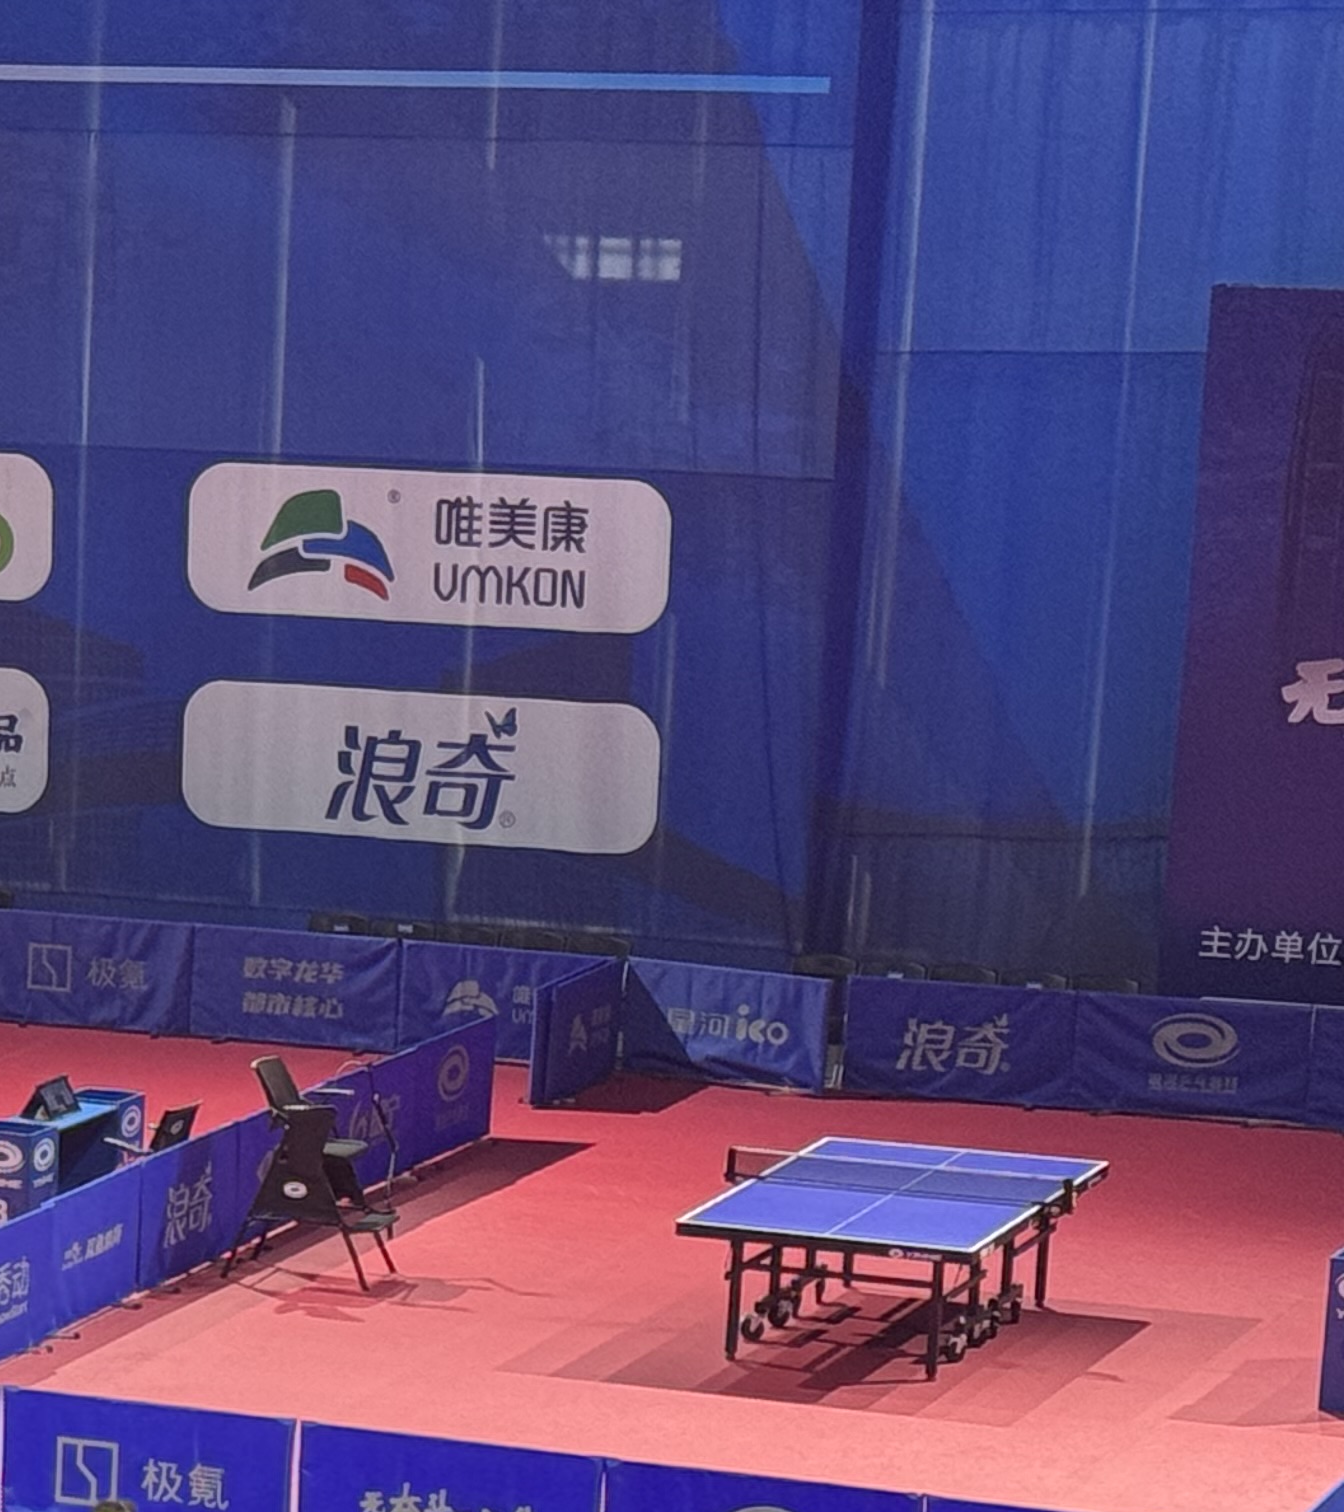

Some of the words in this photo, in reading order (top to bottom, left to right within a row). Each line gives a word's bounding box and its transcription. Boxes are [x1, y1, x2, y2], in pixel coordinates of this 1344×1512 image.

[434, 496, 590, 554] 唯美康
[324, 724, 518, 831] 浪奇
[1198, 924, 1342, 966] 主办单位
[895, 1021, 1010, 1076] 浪奇
[140, 1457, 230, 1511] 极氪
